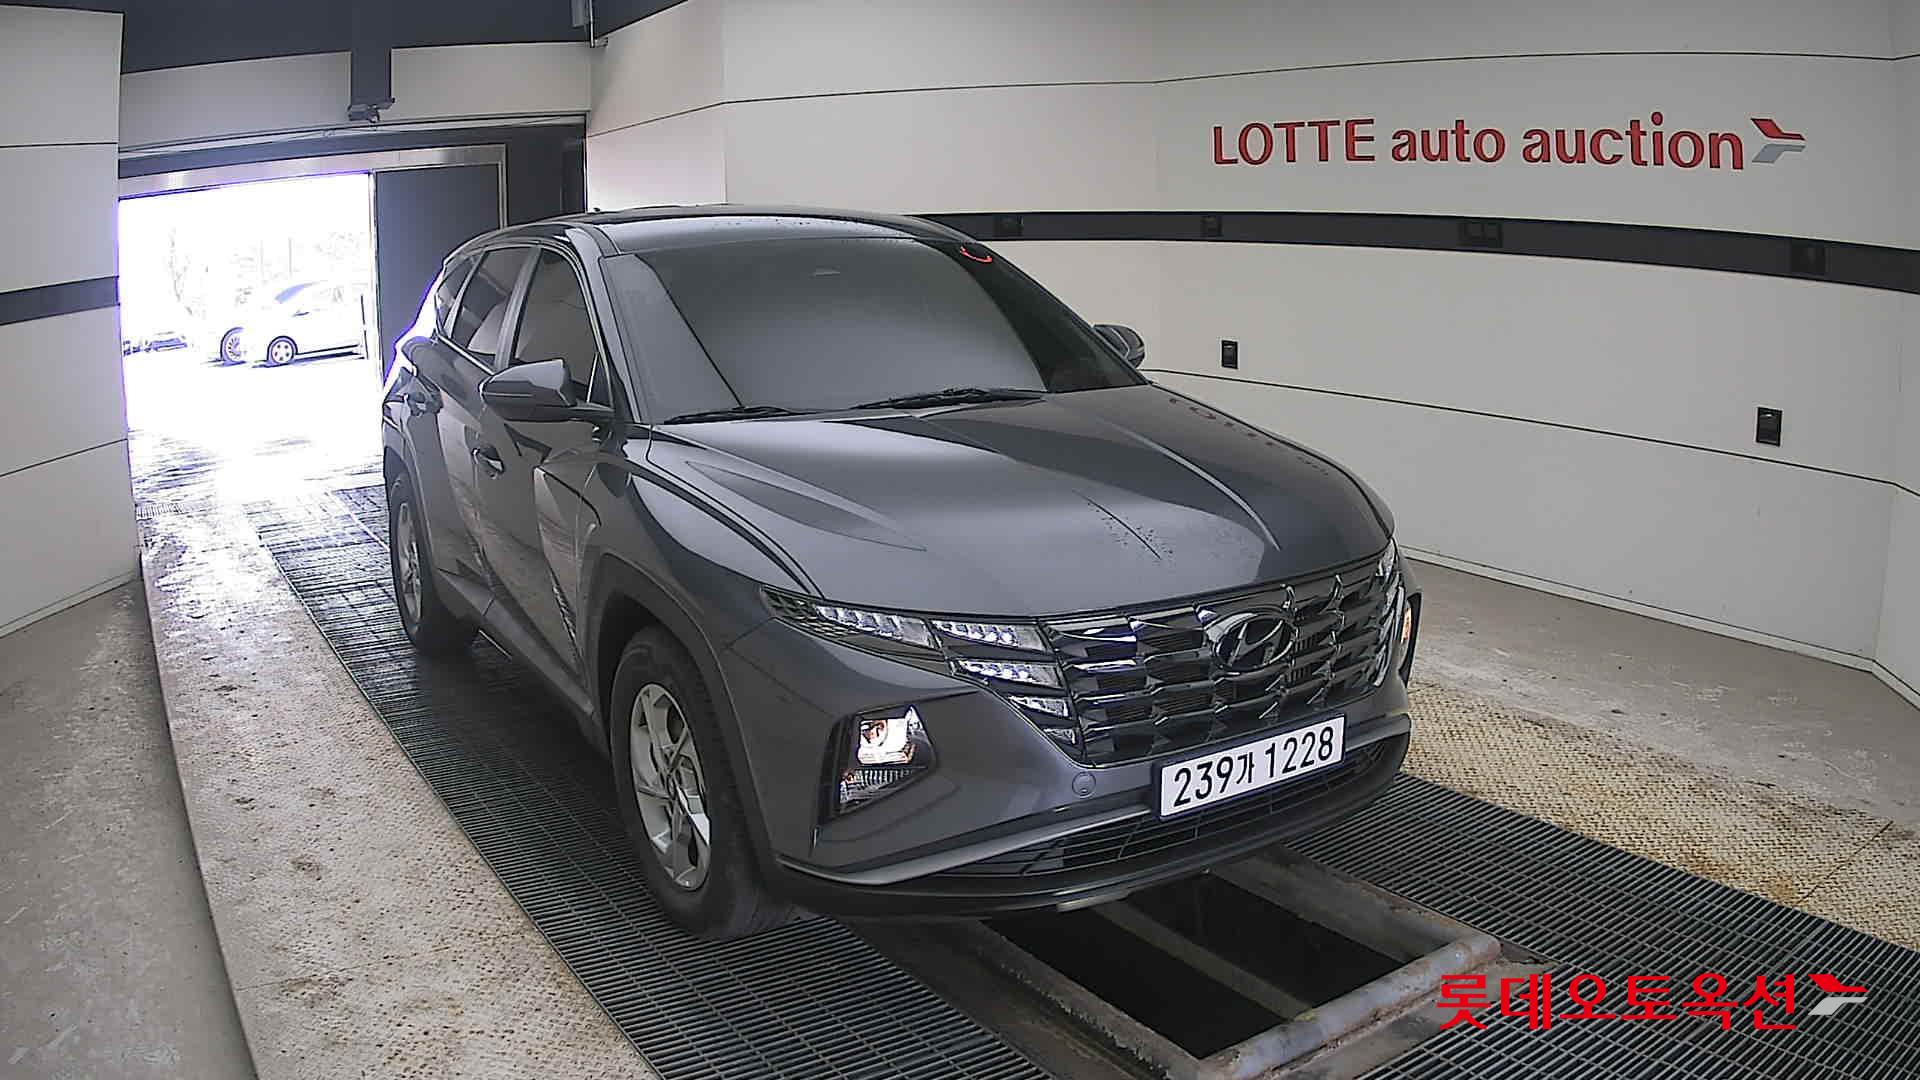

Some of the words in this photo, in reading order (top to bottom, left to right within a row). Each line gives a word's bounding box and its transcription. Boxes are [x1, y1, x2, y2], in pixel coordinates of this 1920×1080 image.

[1212, 118, 1375, 165] LOTTE
[1391, 119, 1506, 164] auto
[1522, 112, 1744, 170] auction
[1173, 752, 1255, 807] 239가
[1265, 726, 1334, 778] 1228
